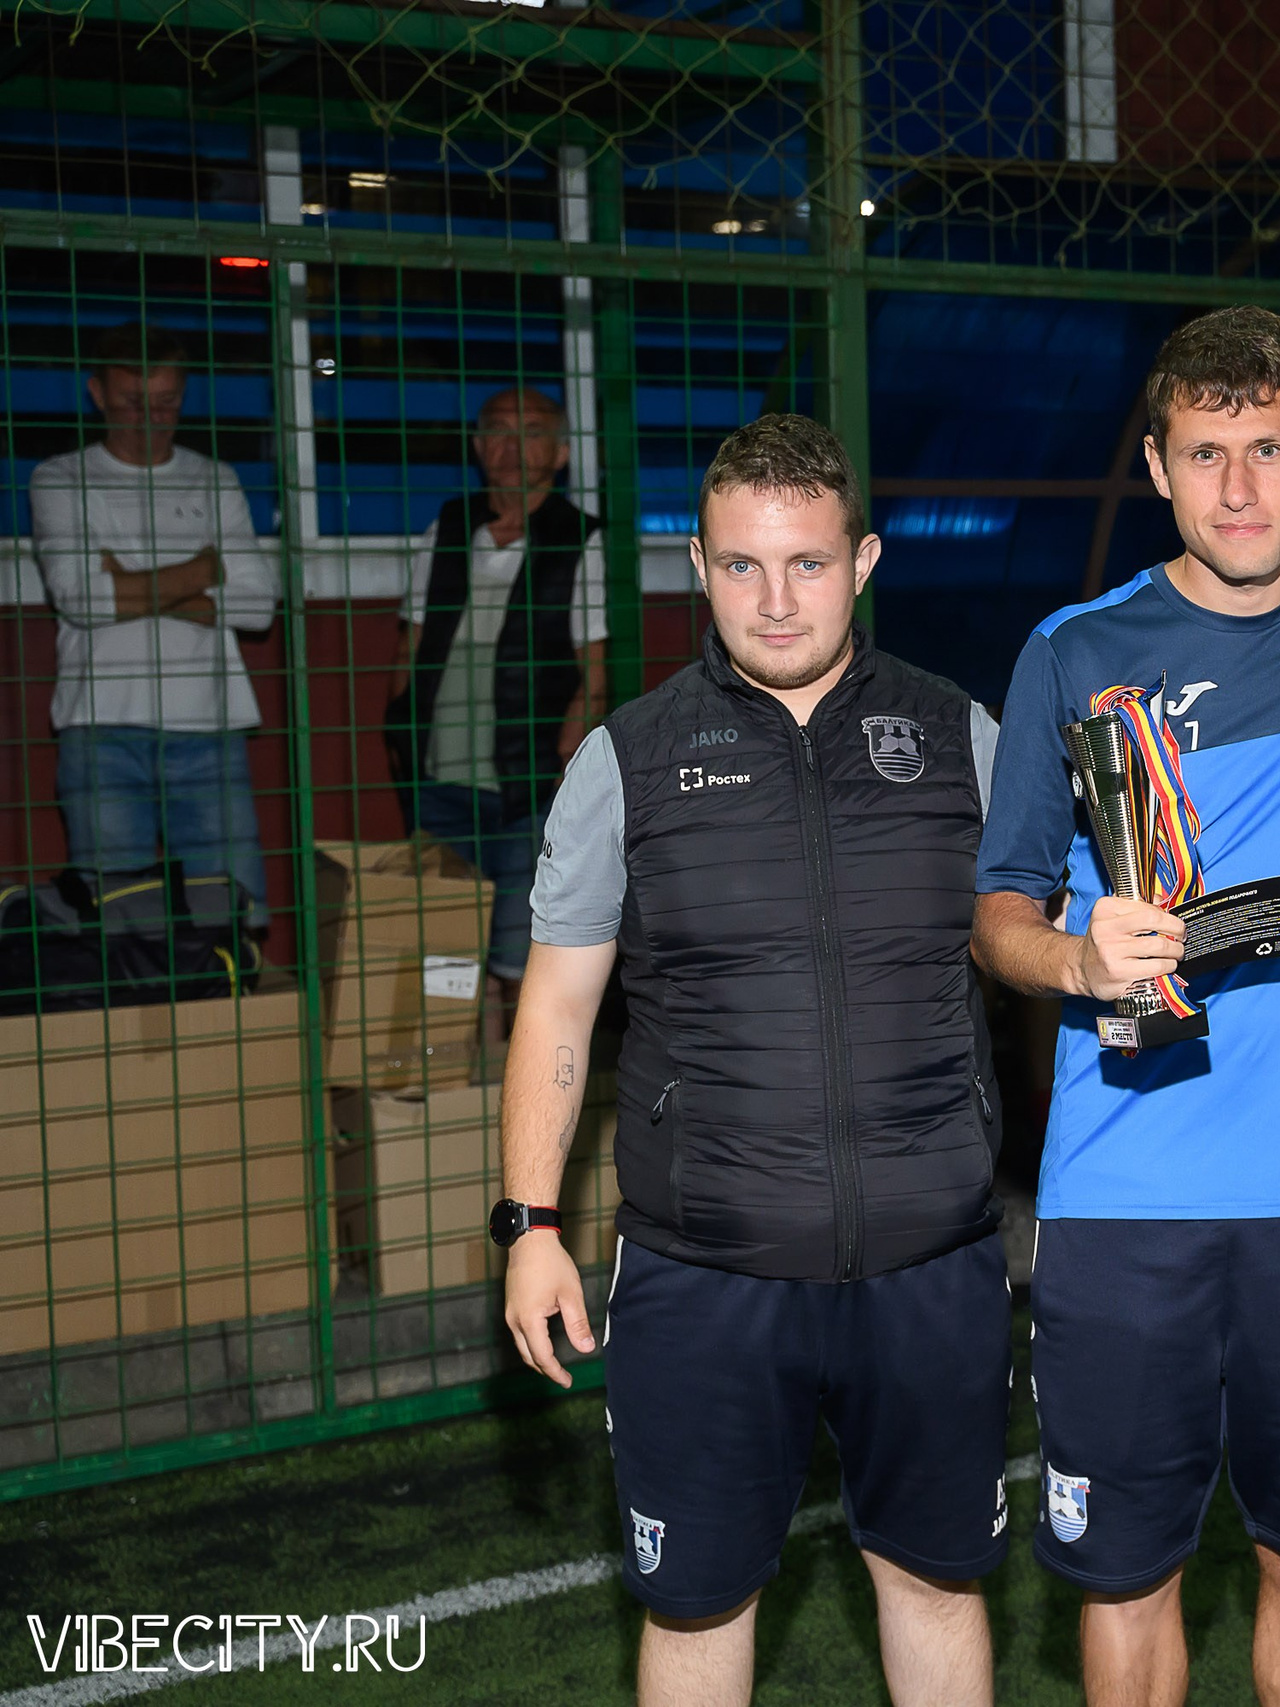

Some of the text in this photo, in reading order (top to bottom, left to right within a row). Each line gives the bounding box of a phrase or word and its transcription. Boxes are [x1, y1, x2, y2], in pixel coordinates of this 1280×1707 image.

[876, 718, 915, 727] БАЛТИКА
[689, 728, 739, 749] JAKO
[707, 774, 751, 786] Ростех
